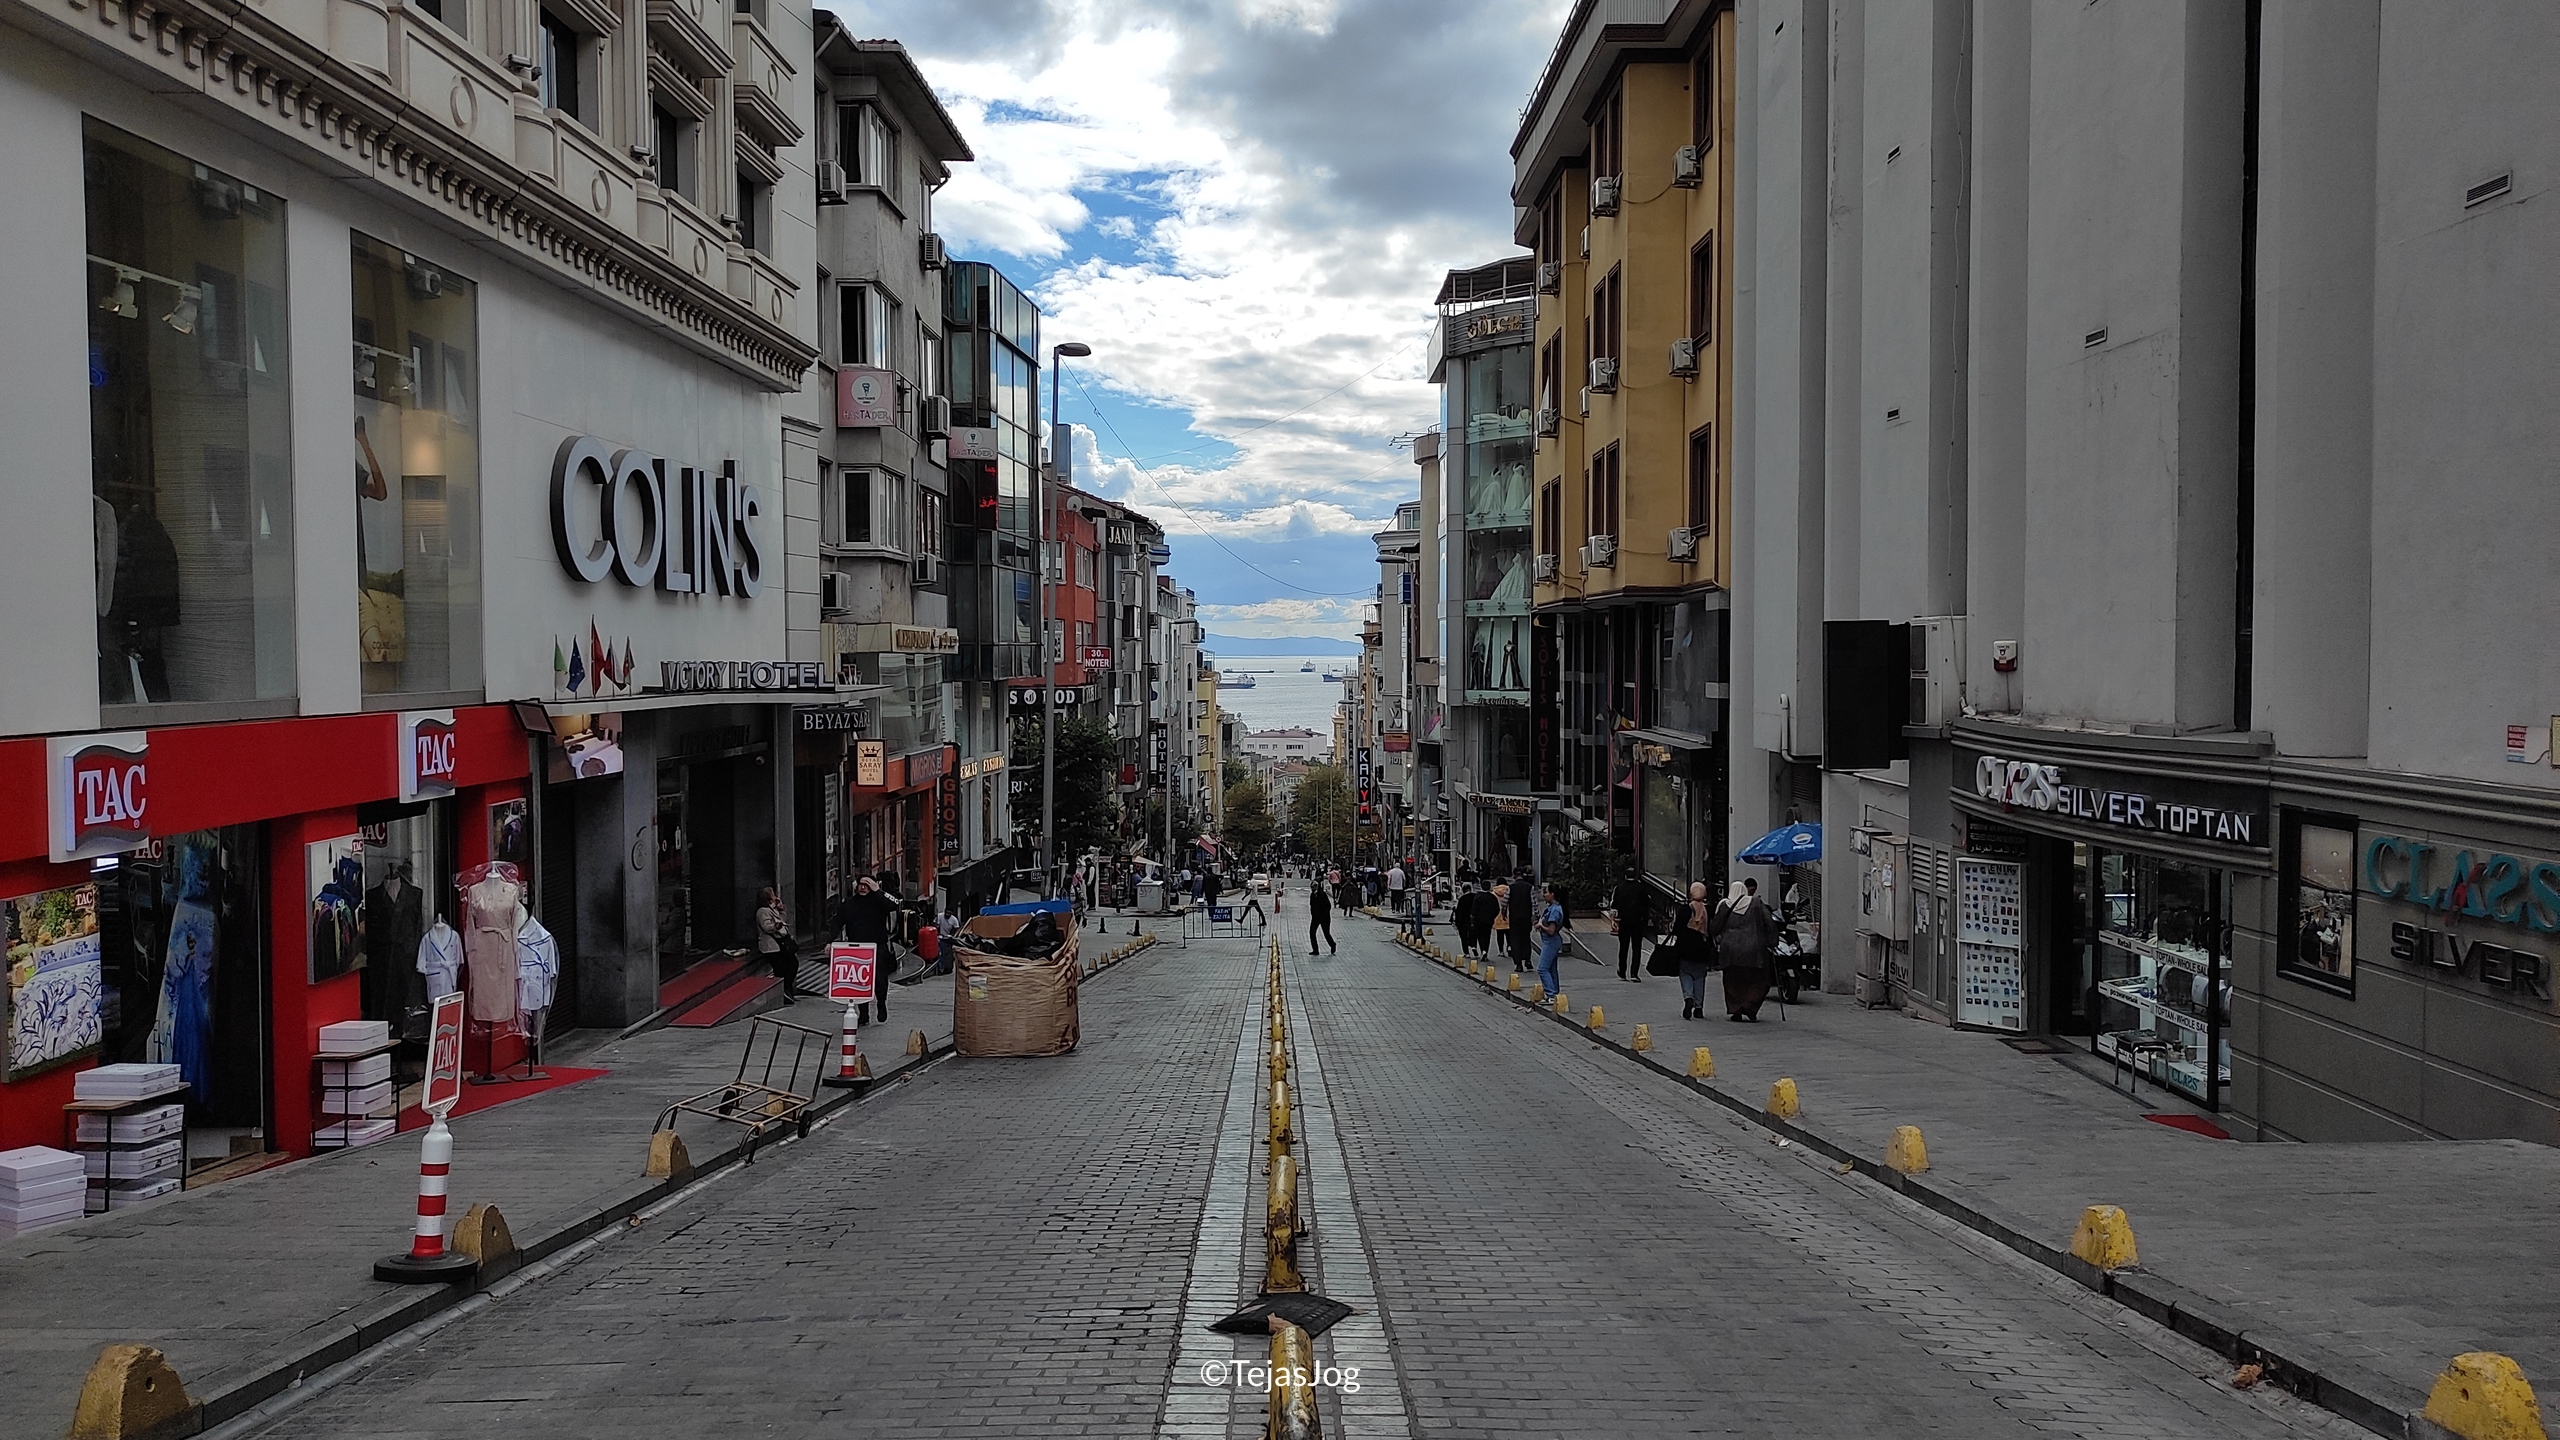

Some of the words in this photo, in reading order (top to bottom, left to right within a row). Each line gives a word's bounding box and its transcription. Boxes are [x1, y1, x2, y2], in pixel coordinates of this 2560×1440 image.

[550, 435, 764, 599] COLIN'S
[662, 661, 728, 692] VICTORY
[730, 661, 835, 689] HOTEL
[1085, 658, 1109, 668] NOTER
[803, 711, 851, 731] BEYAZ
[1157, 728, 1167, 785] HOTEL
[1359, 749, 1370, 815] KARYA
[2058, 785, 2152, 828] SILVER
[2156, 801, 2250, 843] TOPTAN
[940, 837, 959, 851] jet
[2390, 920, 2550, 1001] SILVER
